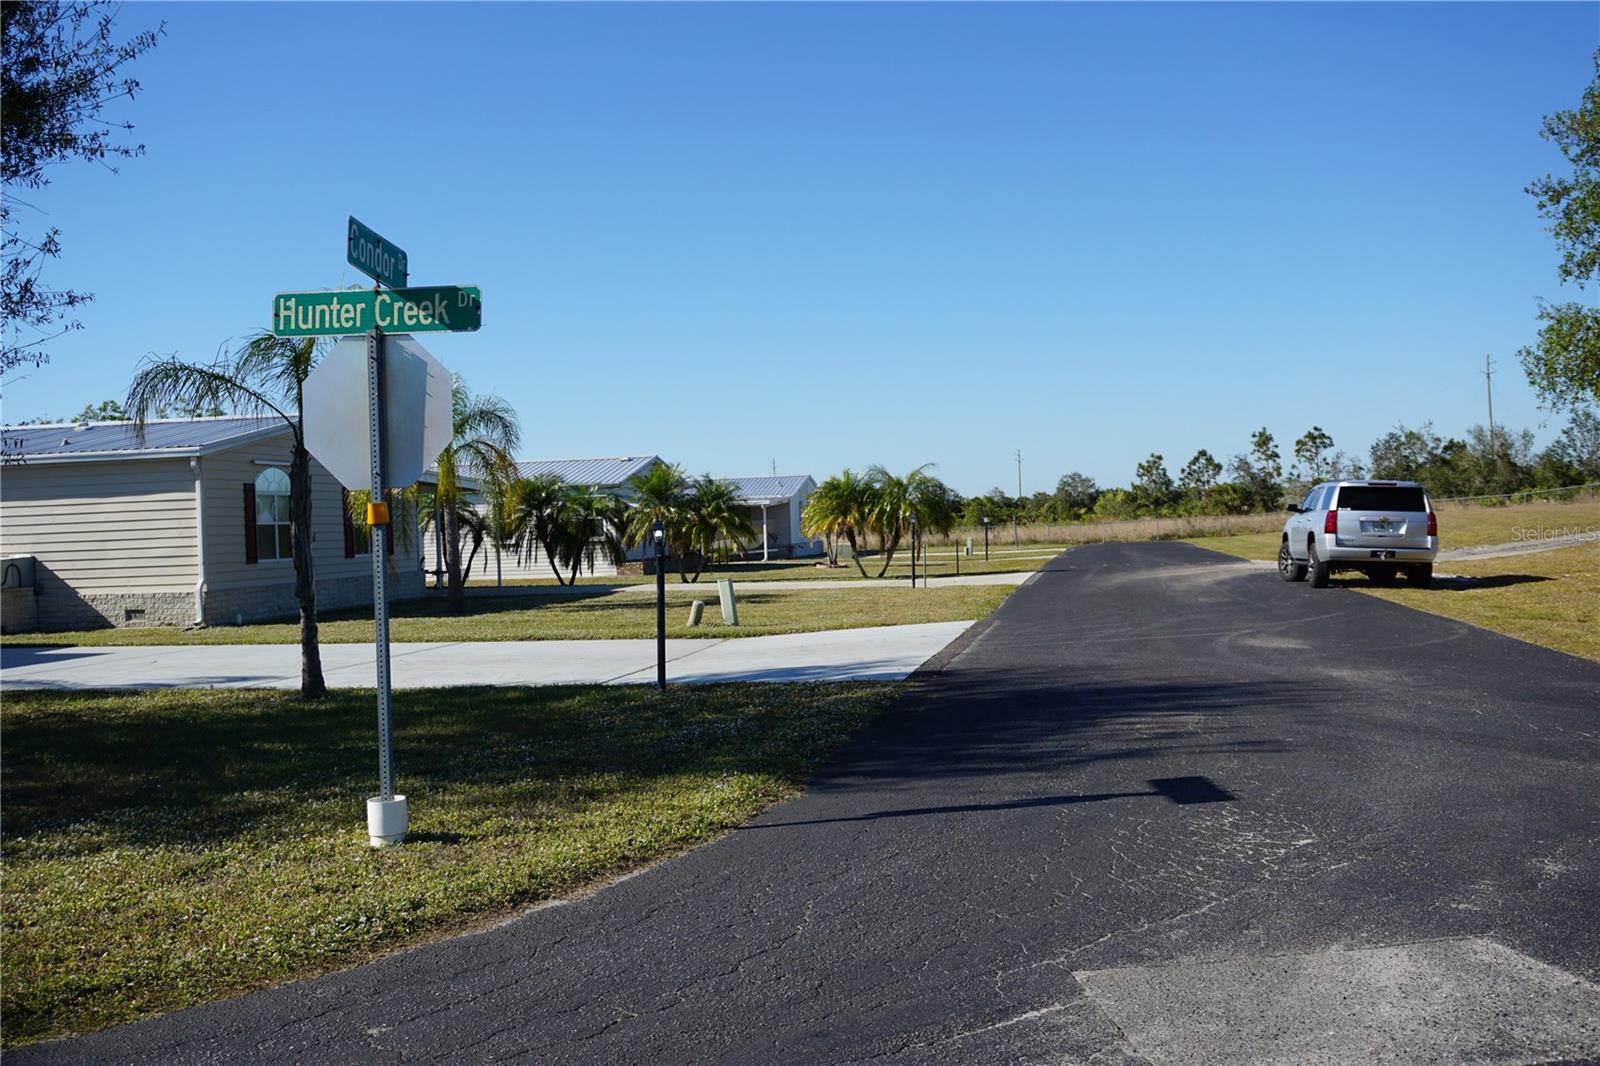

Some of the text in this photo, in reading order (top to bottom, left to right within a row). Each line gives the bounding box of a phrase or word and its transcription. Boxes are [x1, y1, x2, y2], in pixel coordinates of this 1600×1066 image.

[350, 223, 395, 280] Condor
[279, 290, 476, 330] Hunter Creek Dr
